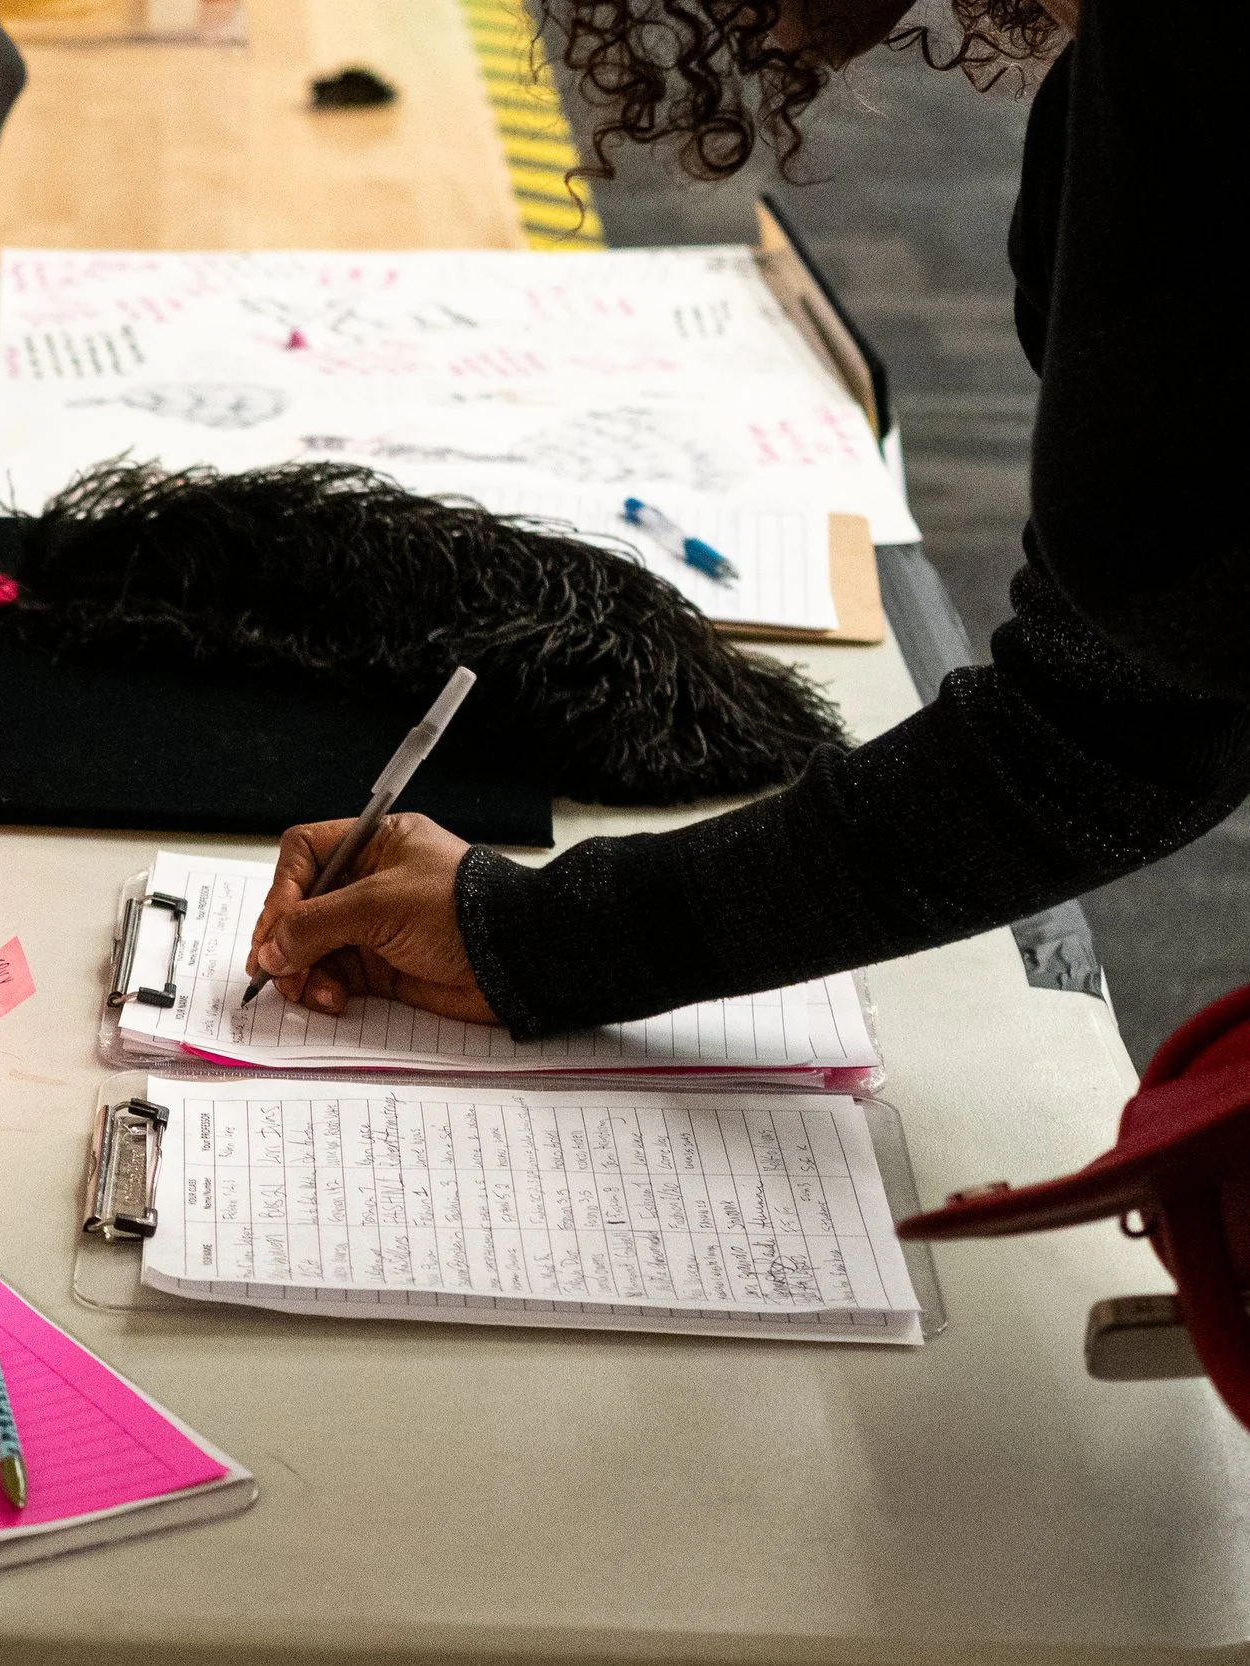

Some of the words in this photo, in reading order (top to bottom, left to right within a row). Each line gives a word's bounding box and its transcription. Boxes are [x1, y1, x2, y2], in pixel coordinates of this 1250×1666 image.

[197, 885, 210, 911] PROFESSOR
[176, 995, 189, 1009] NAME
[200, 1113, 211, 1138] PROFESSOR
[201, 1139, 211, 1152] Your
[188, 1179, 198, 1191] CLASS
[188, 1191, 198, 1205] YOUR
[203, 1178, 213, 1210] Name/Number
